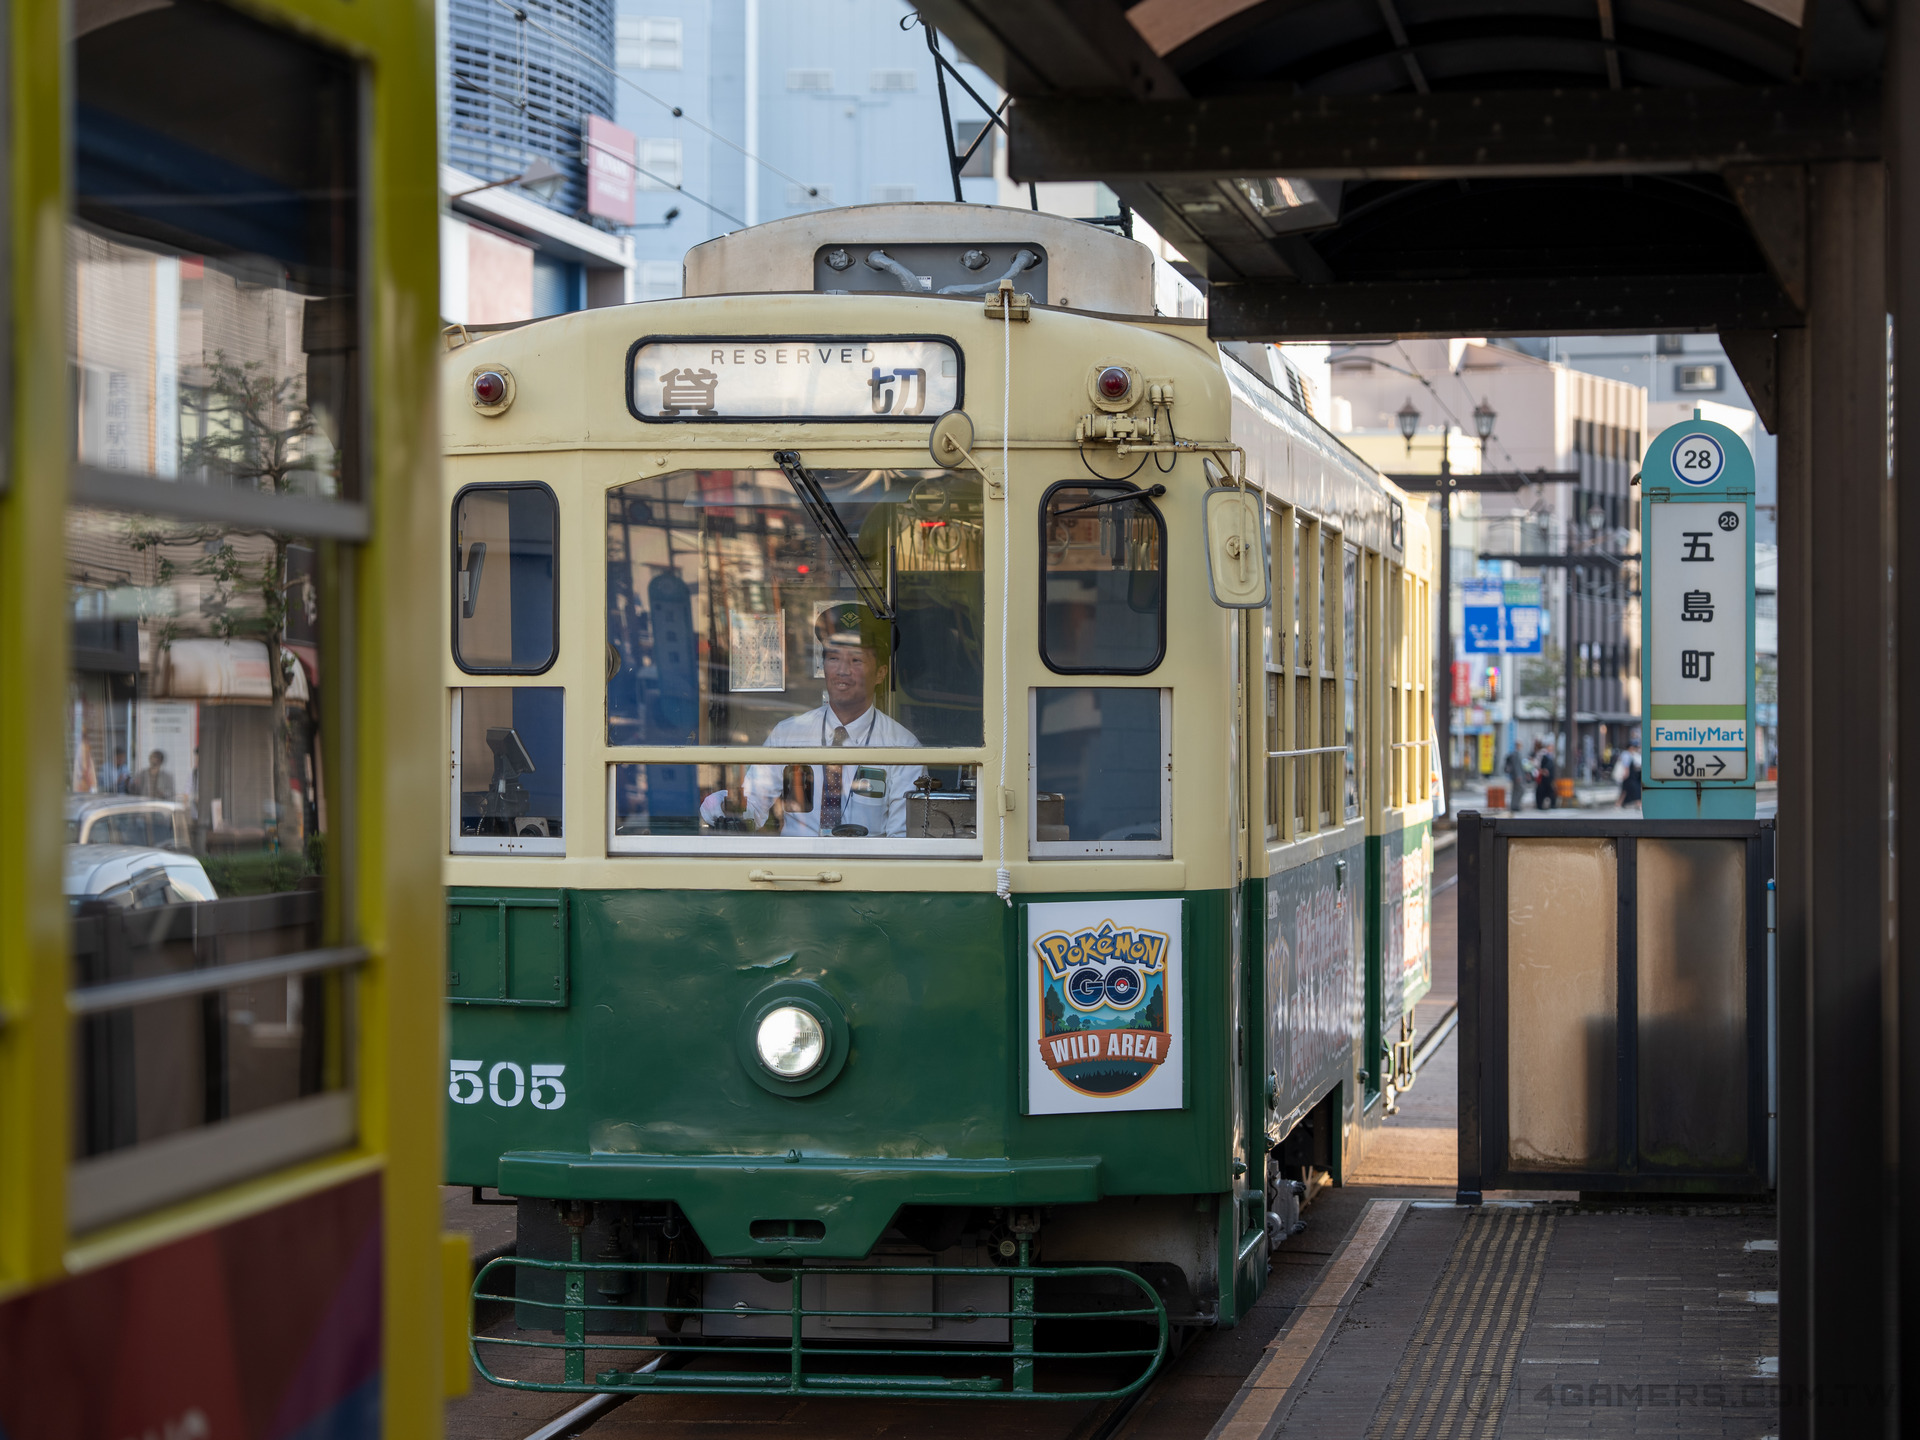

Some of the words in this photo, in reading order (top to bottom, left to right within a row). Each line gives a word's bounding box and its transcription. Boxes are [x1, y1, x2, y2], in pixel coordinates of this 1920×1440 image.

[711, 348, 875, 364] RESERVED
[1684, 450, 1712, 469] 28
[1720, 515, 1737, 528] 28
[1681, 532, 1715, 682] 五島町
[1655, 727, 1744, 745] FamilyMart
[1069, 966, 1141, 1006] GO
[1049, 1036, 1101, 1064] WILD
[1107, 1033, 1158, 1060] AREA
[449, 1059, 567, 1110] 505
